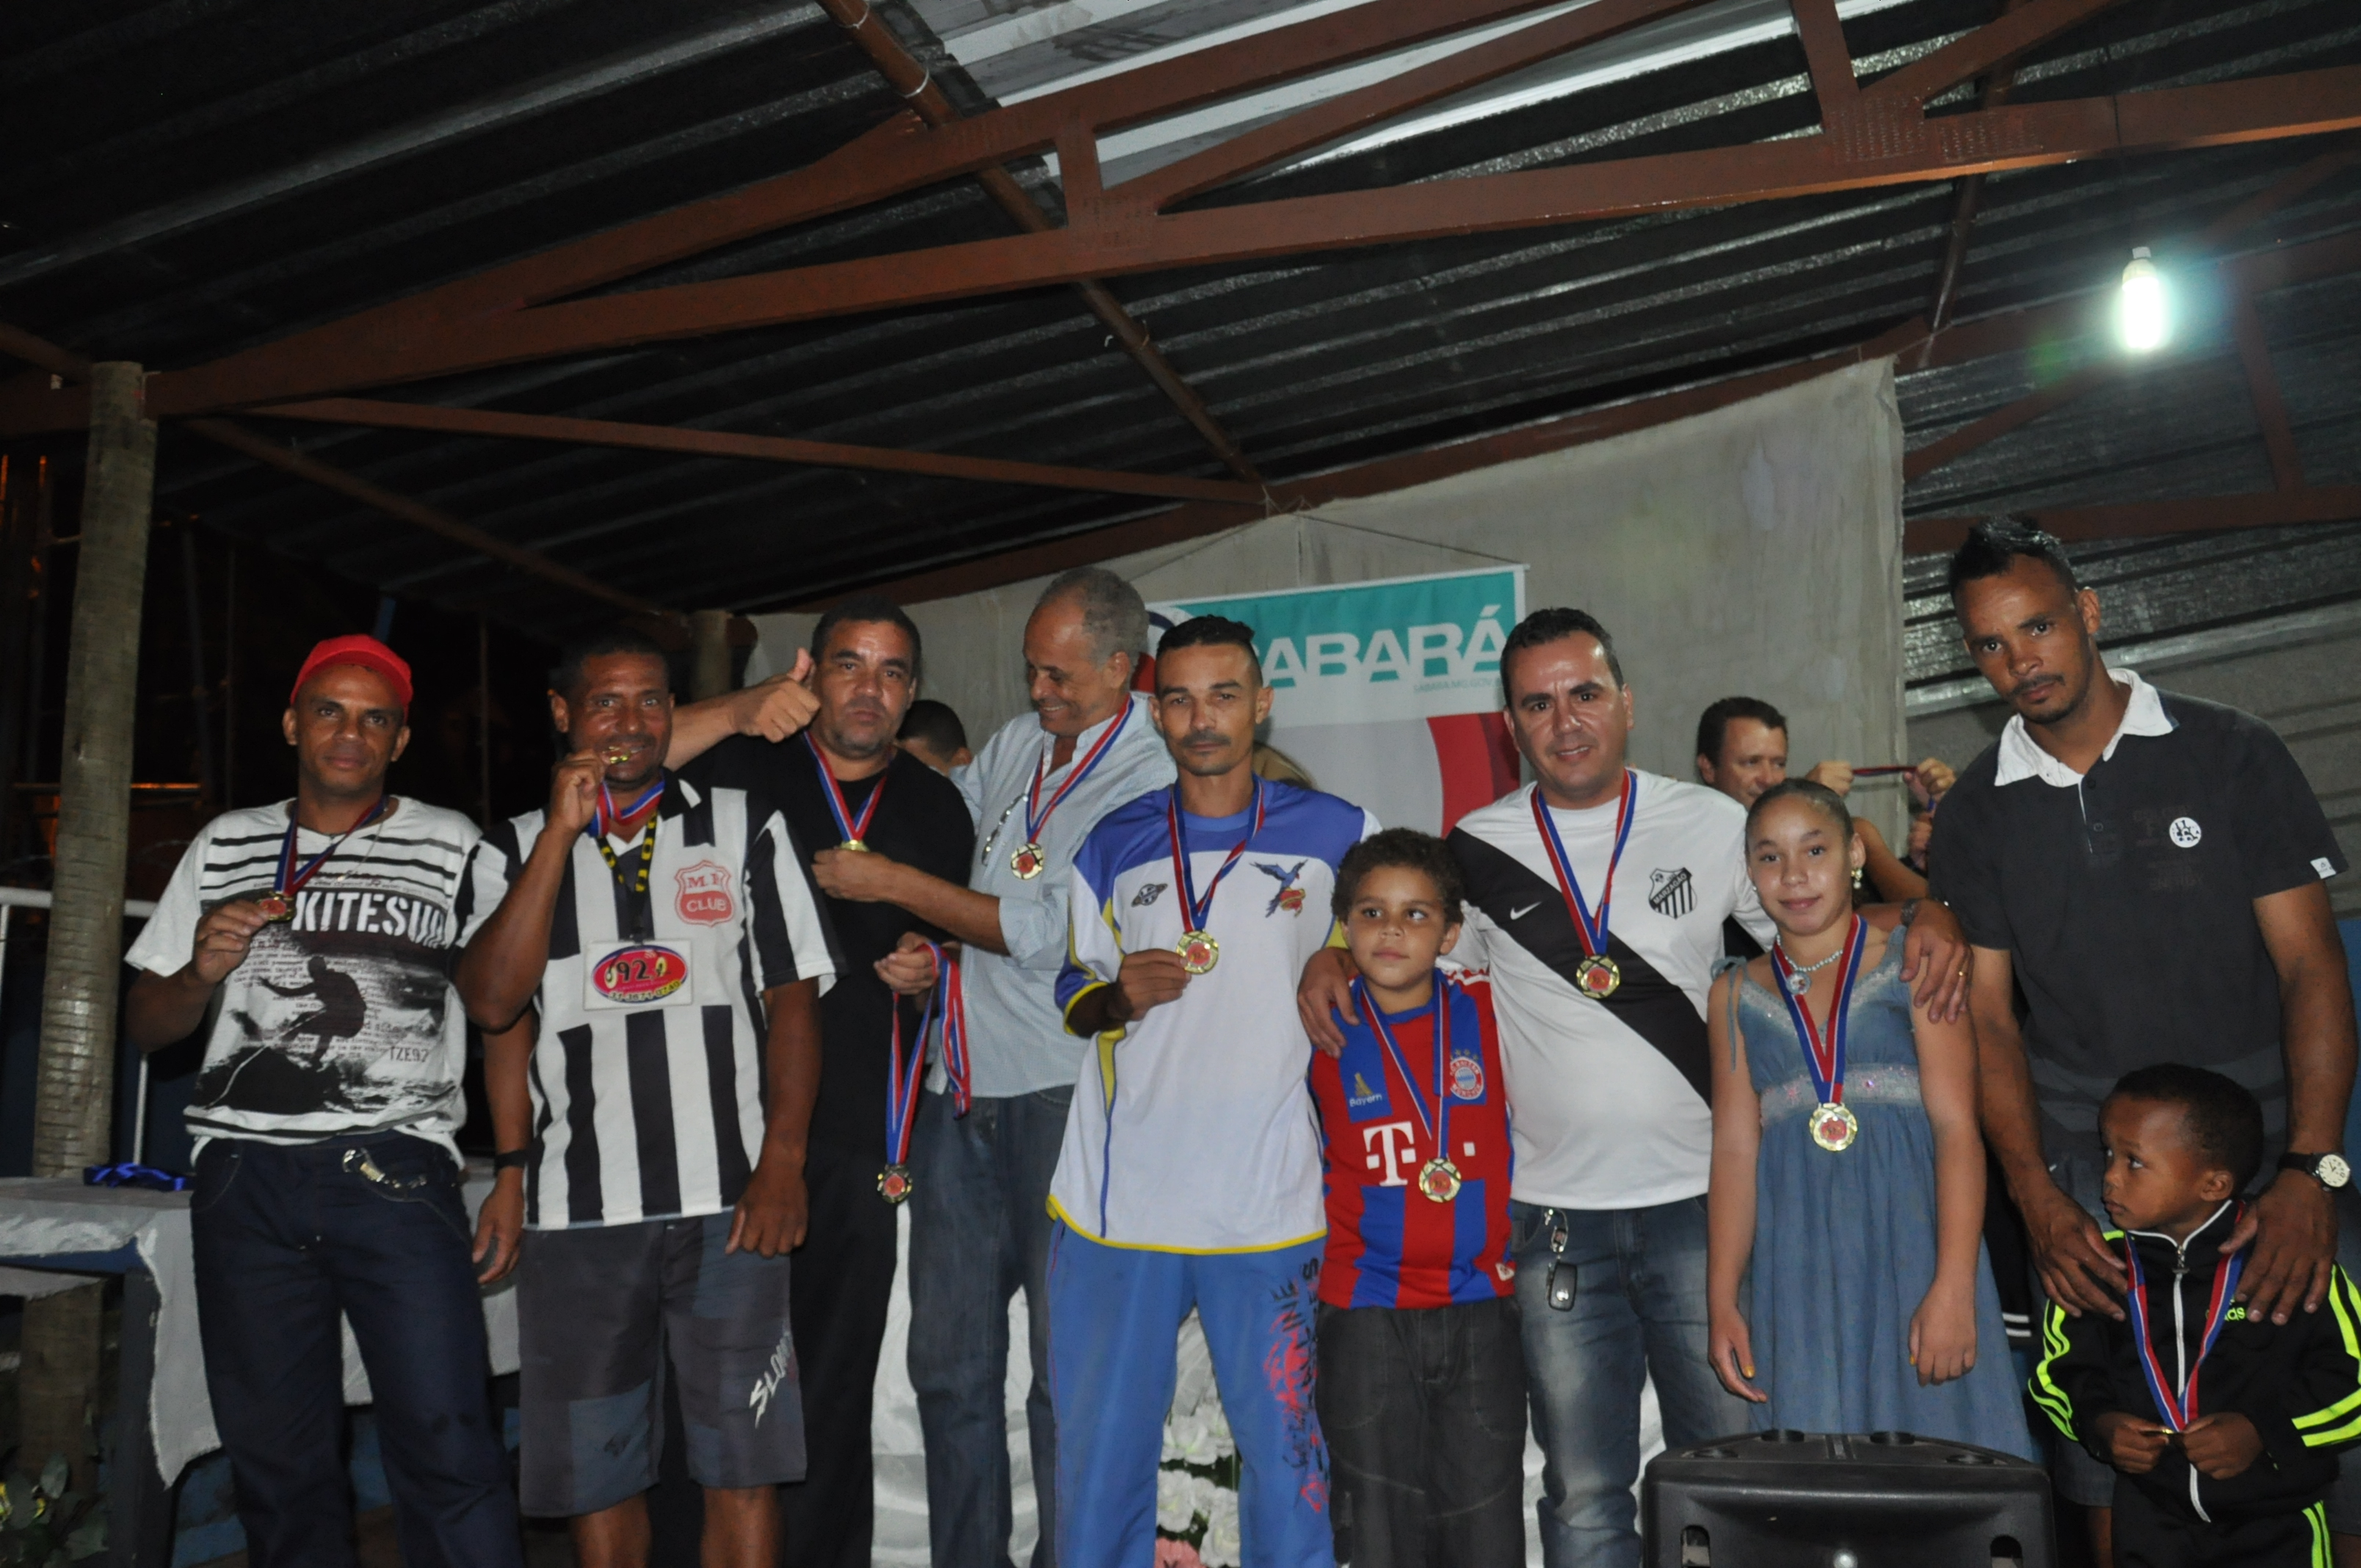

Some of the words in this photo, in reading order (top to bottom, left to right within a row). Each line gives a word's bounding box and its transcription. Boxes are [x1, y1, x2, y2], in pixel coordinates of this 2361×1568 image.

[1252, 604, 1505, 689] ABARÁ
[686, 898, 726, 912] CLUB
[1349, 1093, 1383, 1107] Bayern
